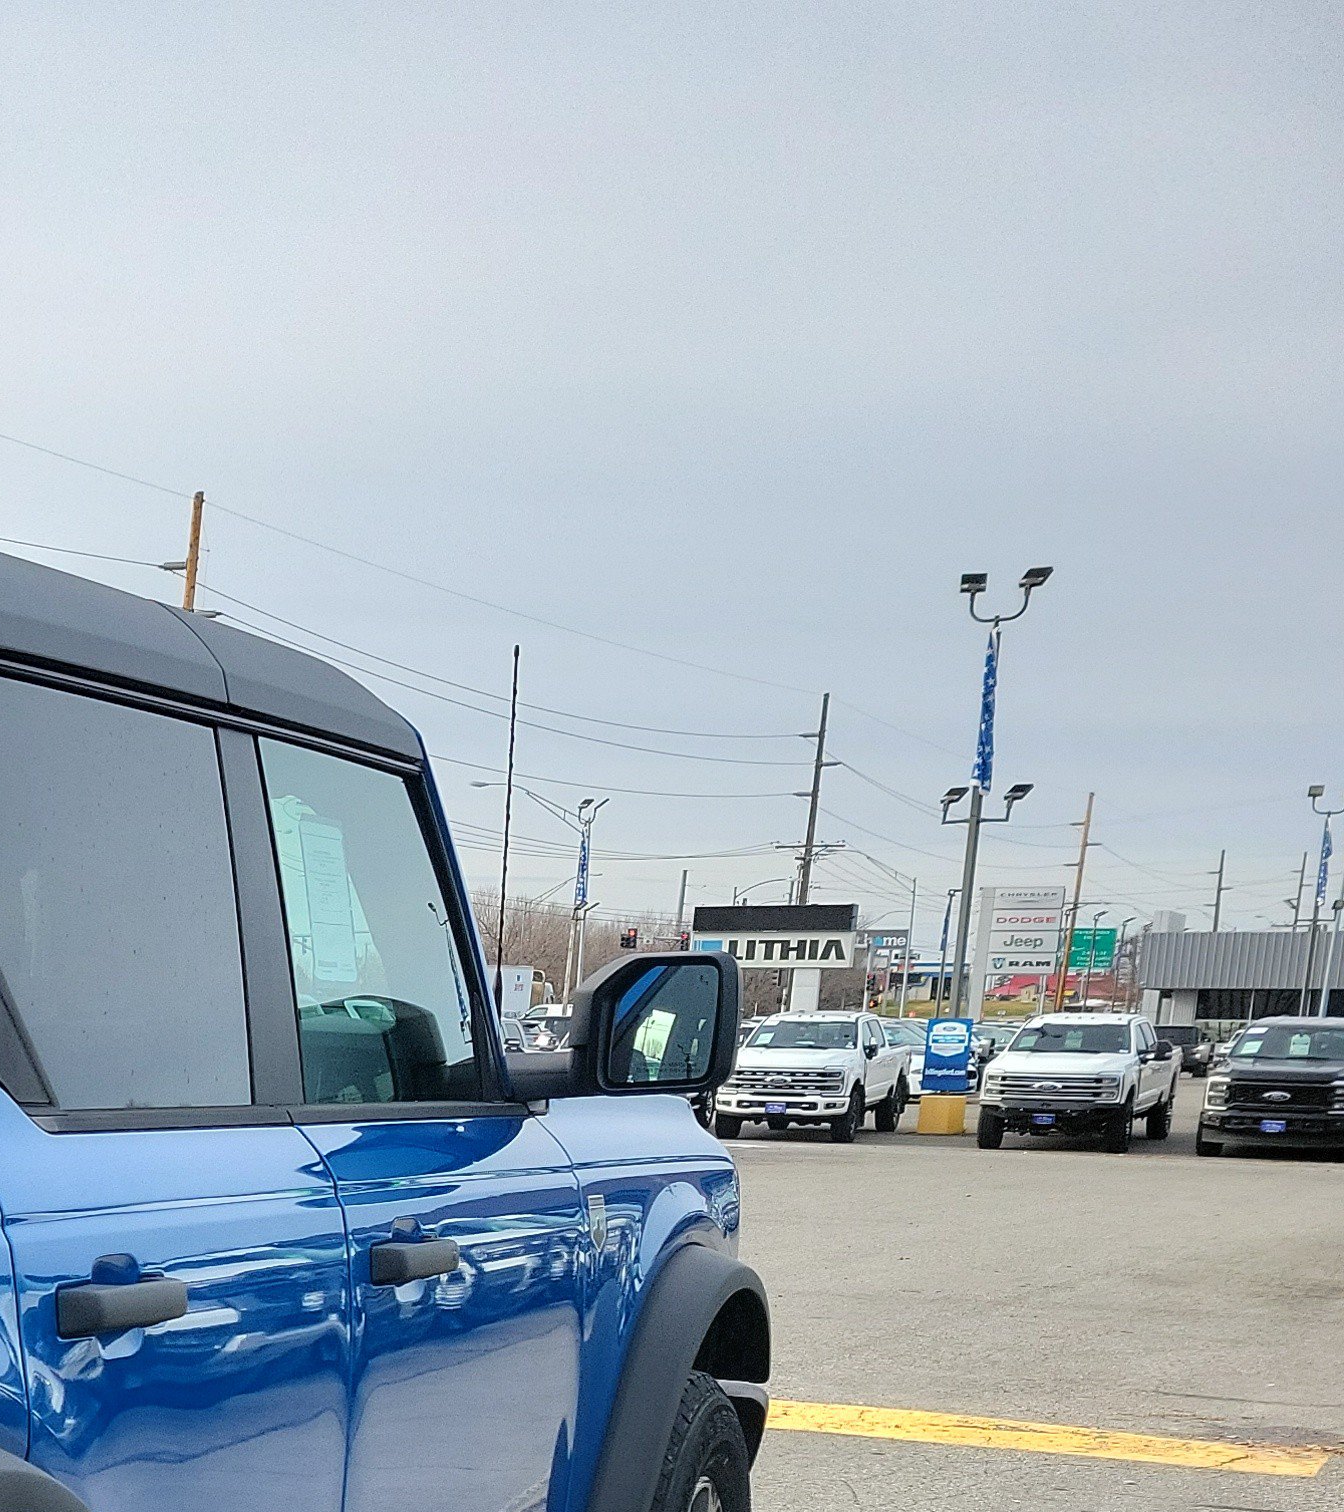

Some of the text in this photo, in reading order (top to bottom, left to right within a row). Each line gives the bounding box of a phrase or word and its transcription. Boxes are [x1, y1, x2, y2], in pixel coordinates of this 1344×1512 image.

[996, 916, 1056, 924] DODGE
[1003, 934, 1044, 949] Jeep
[728, 939, 846, 961] LITHIA
